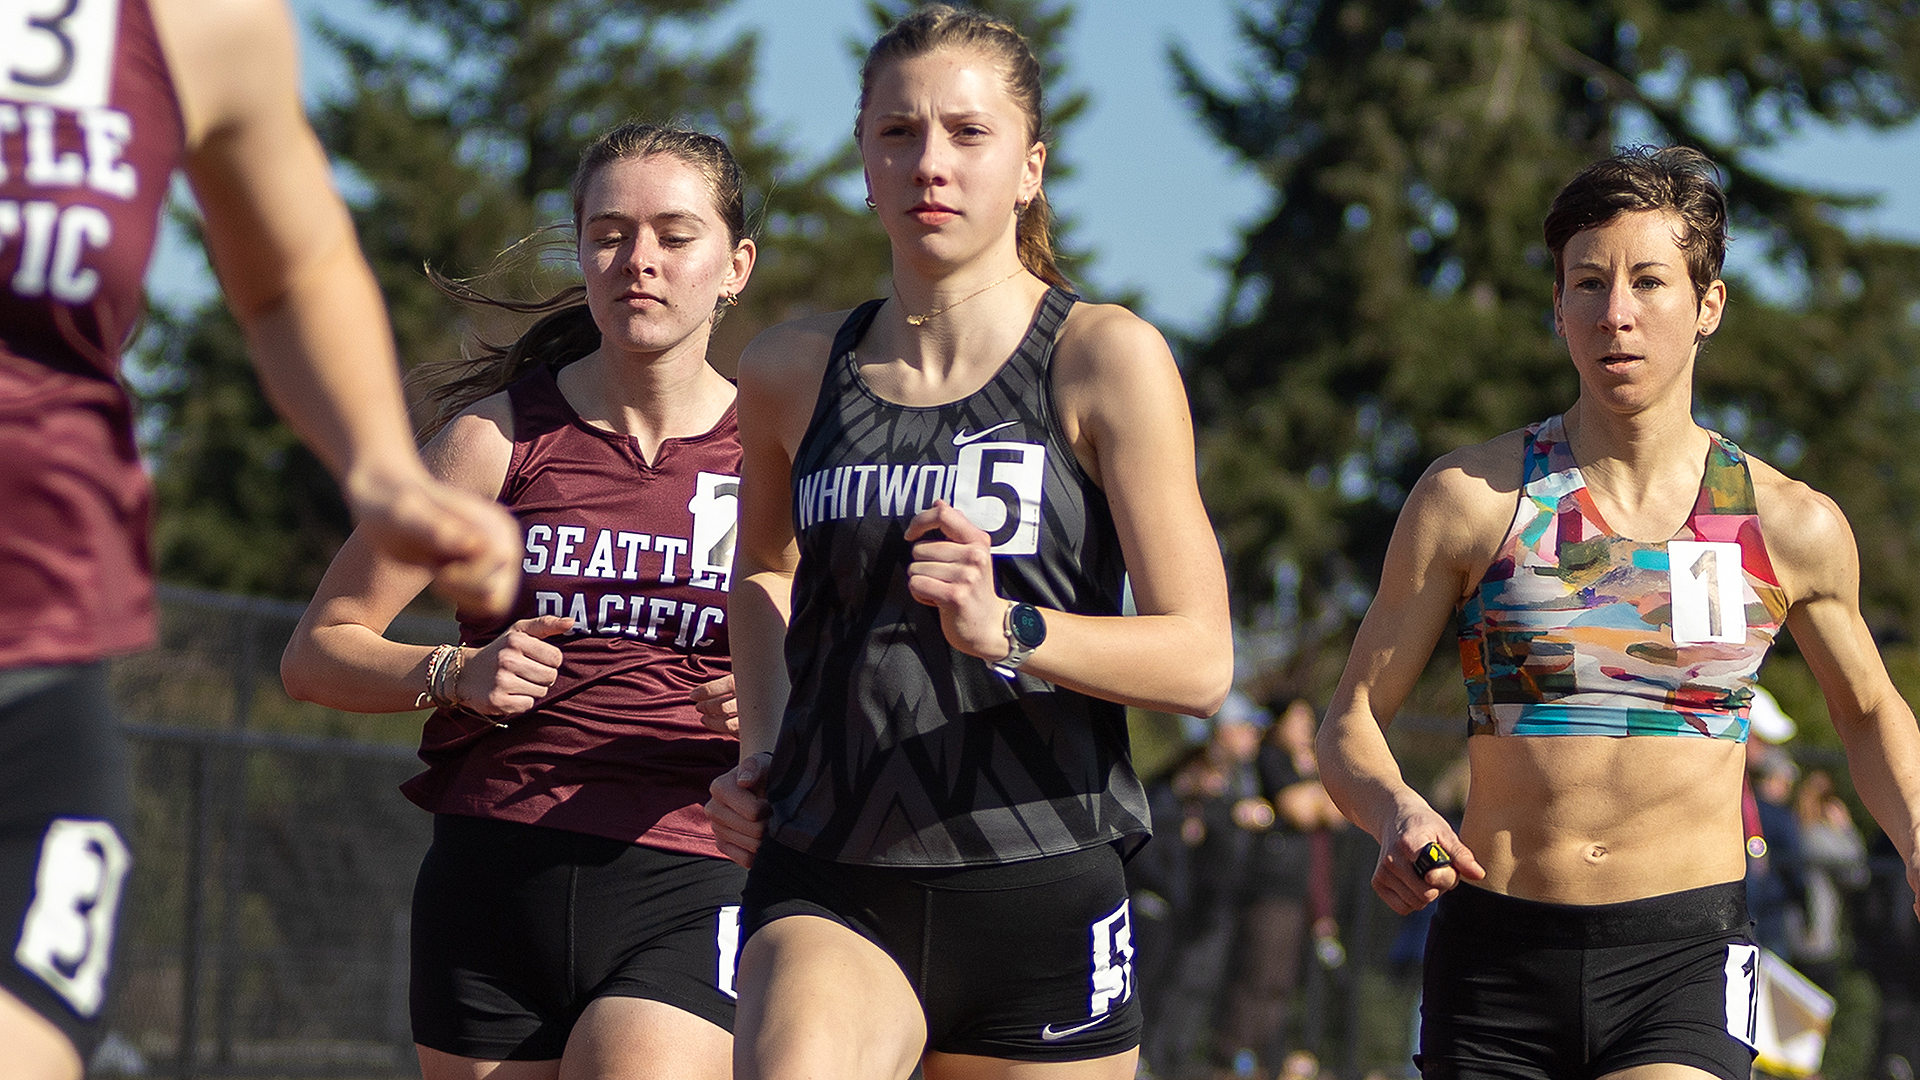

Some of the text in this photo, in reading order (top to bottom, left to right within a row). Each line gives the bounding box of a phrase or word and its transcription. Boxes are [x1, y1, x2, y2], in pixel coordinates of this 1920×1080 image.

[9, 0, 77, 87] 3
[976, 448, 1025, 548] 5
[535, 591, 725, 648] PACIFIC
[1689, 549, 1723, 637] 1
[49, 838, 106, 980] 3
